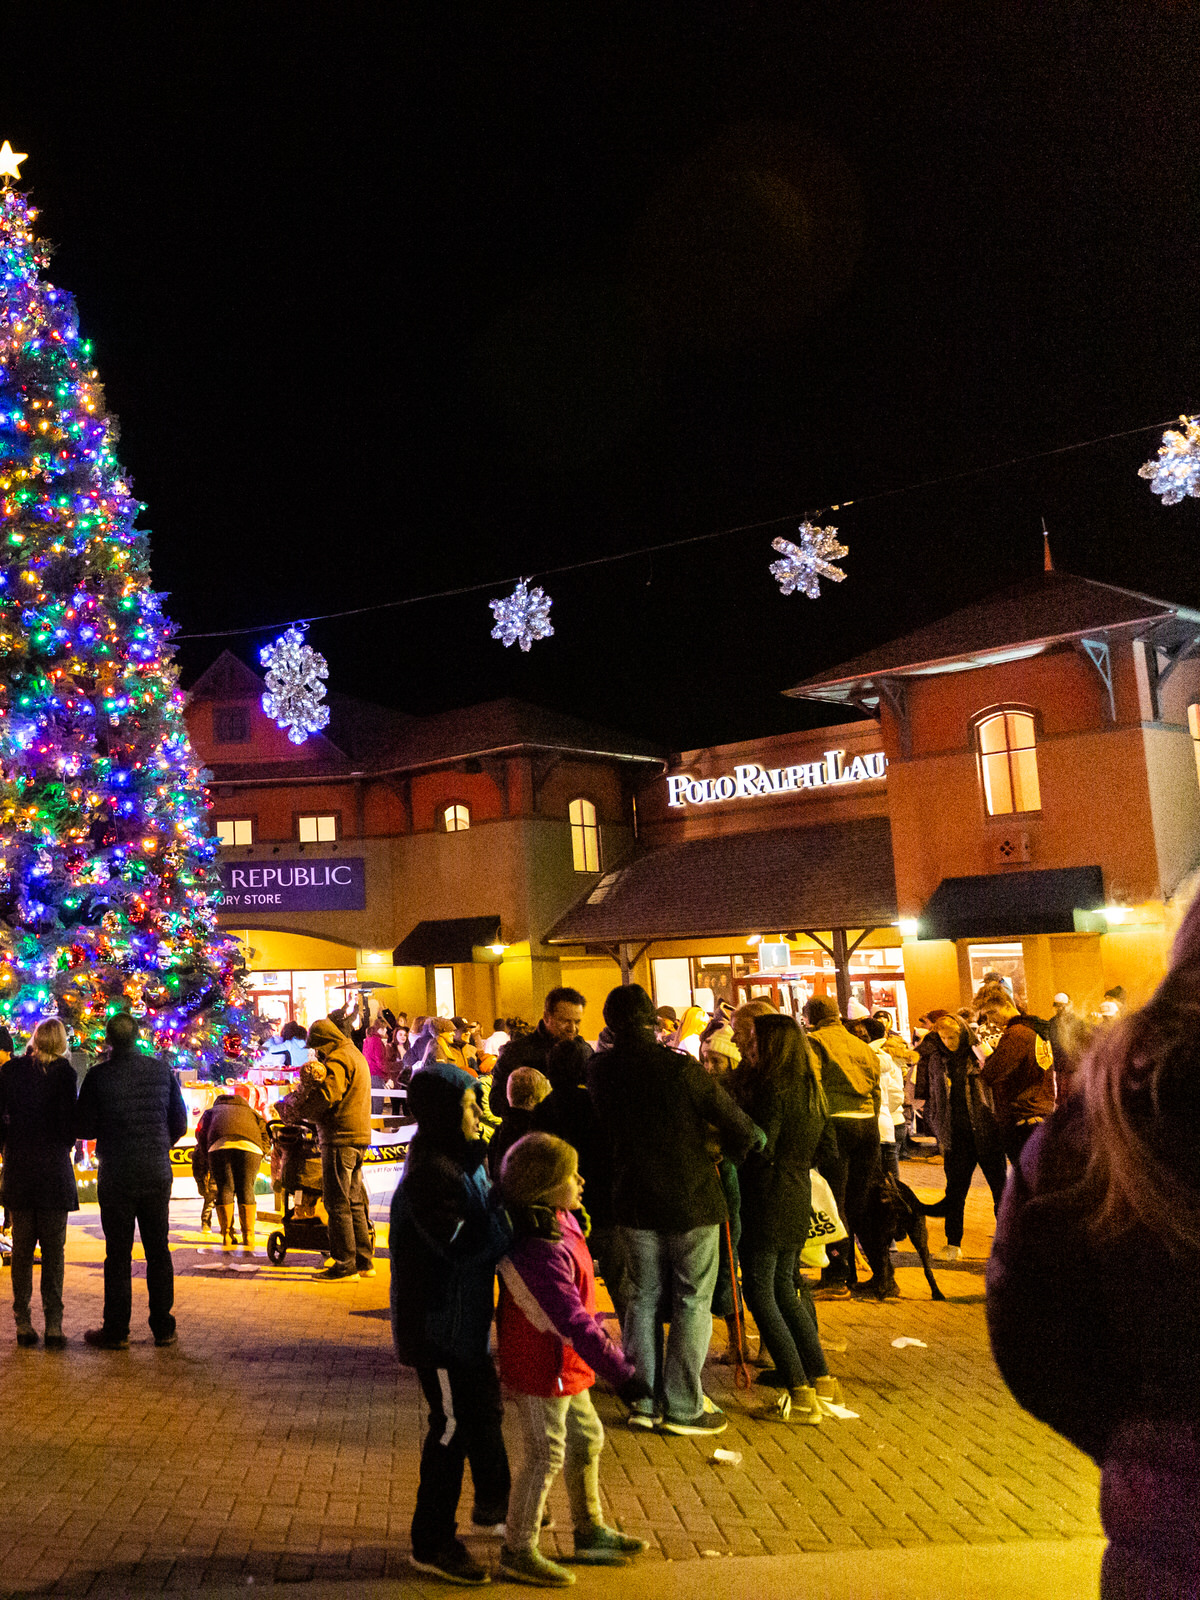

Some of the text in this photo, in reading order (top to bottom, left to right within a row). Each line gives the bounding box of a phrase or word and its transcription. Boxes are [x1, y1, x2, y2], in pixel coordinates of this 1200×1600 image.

[666, 750, 889, 807] POLO RALPH LAU
[231, 866, 352, 888] REPUBLIC
[244, 893, 282, 905] STORE
